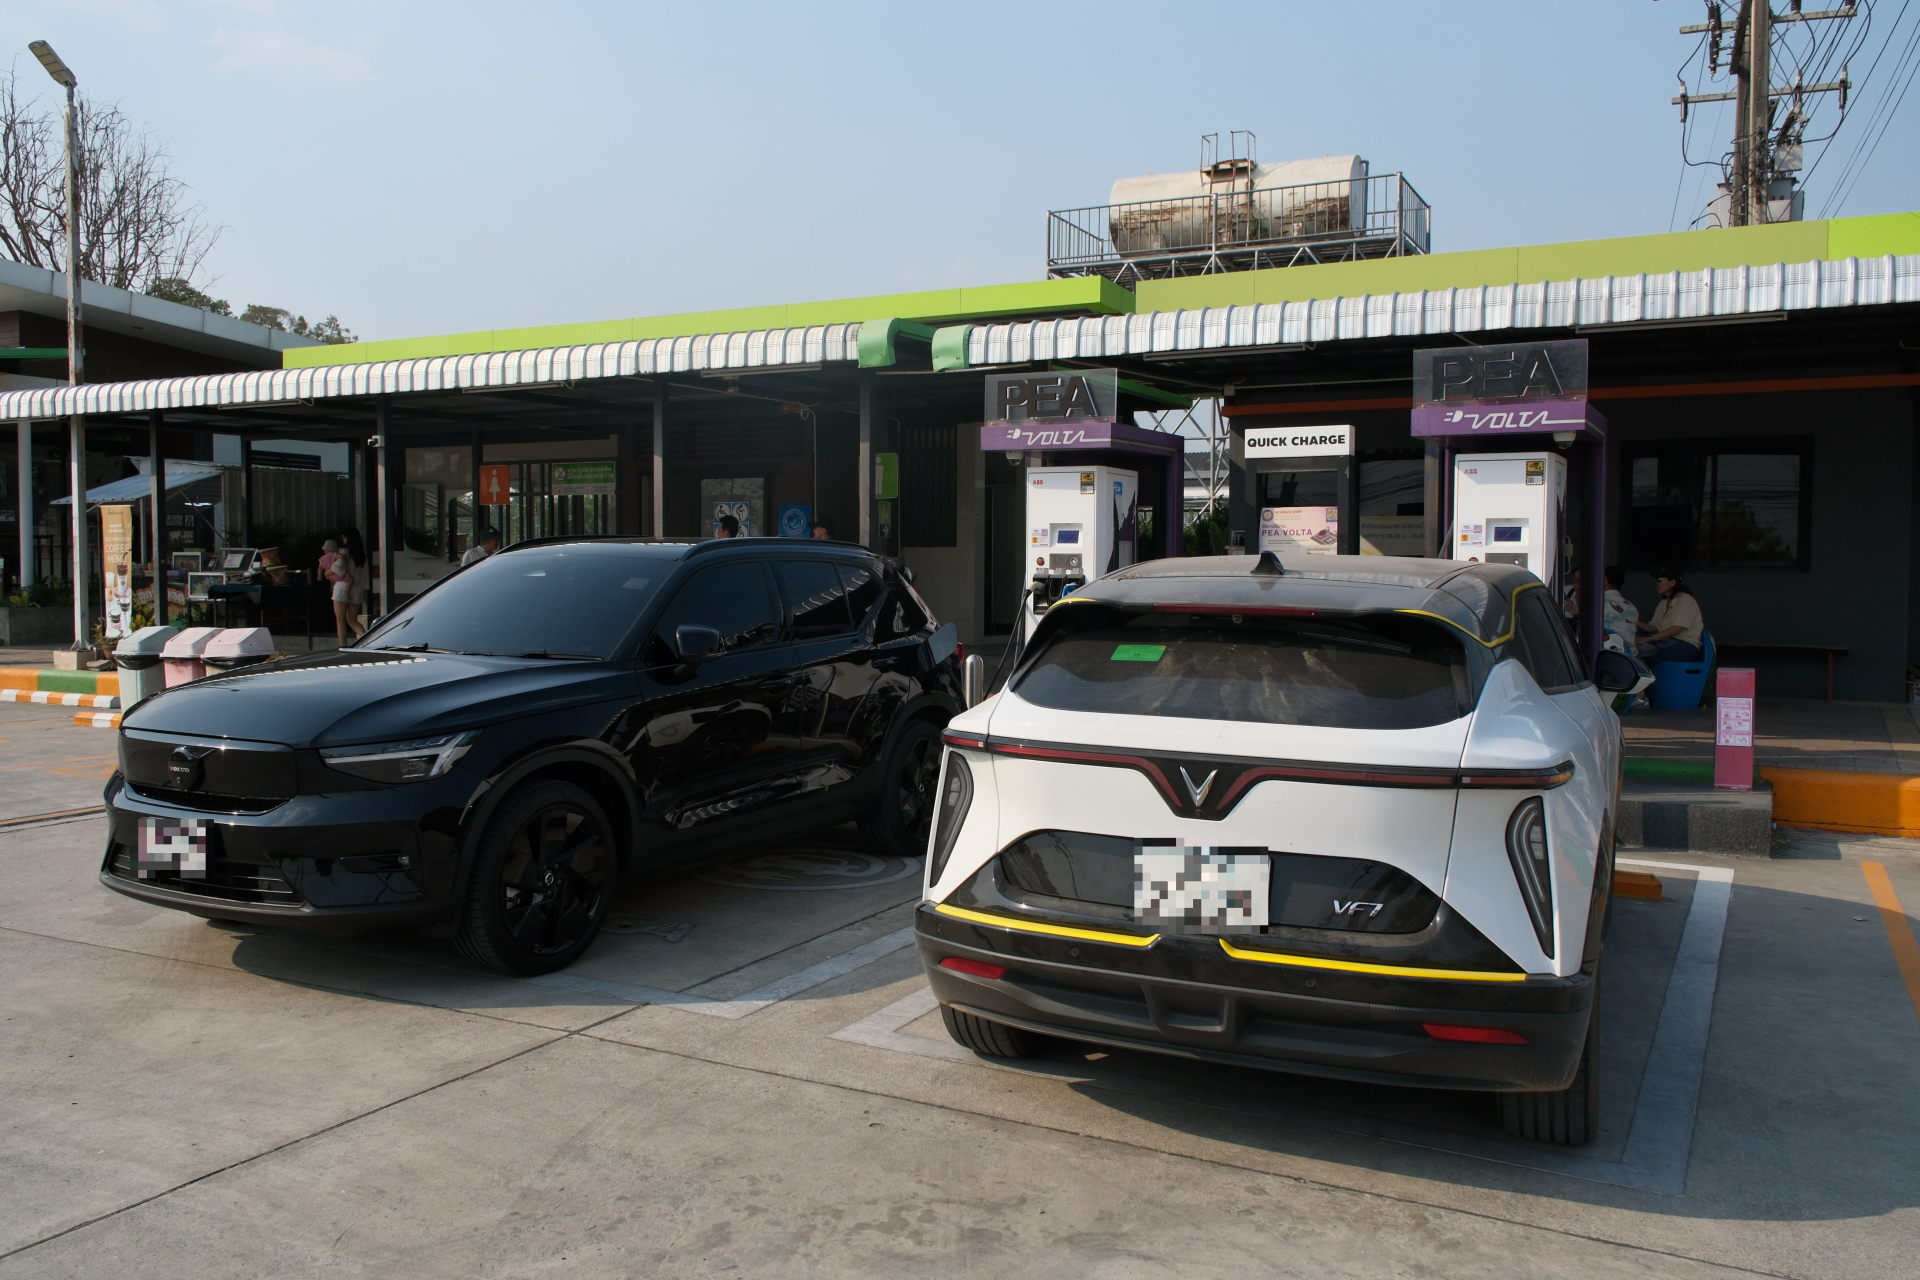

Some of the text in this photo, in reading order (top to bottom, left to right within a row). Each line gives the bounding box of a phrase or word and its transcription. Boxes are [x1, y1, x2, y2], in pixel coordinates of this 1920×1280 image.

[1437, 349, 1563, 401] PEA
[997, 376, 1098, 420] PEA
[1464, 410, 1586, 429] VOLTA
[1021, 430, 1111, 445] VOLTA
[1247, 434, 1346, 448] QUICK CHARGE
[1261, 528, 1313, 537] PEA VOLTA
[105, 543, 130, 553] COFFEE
[1333, 900, 1384, 917] VF7
